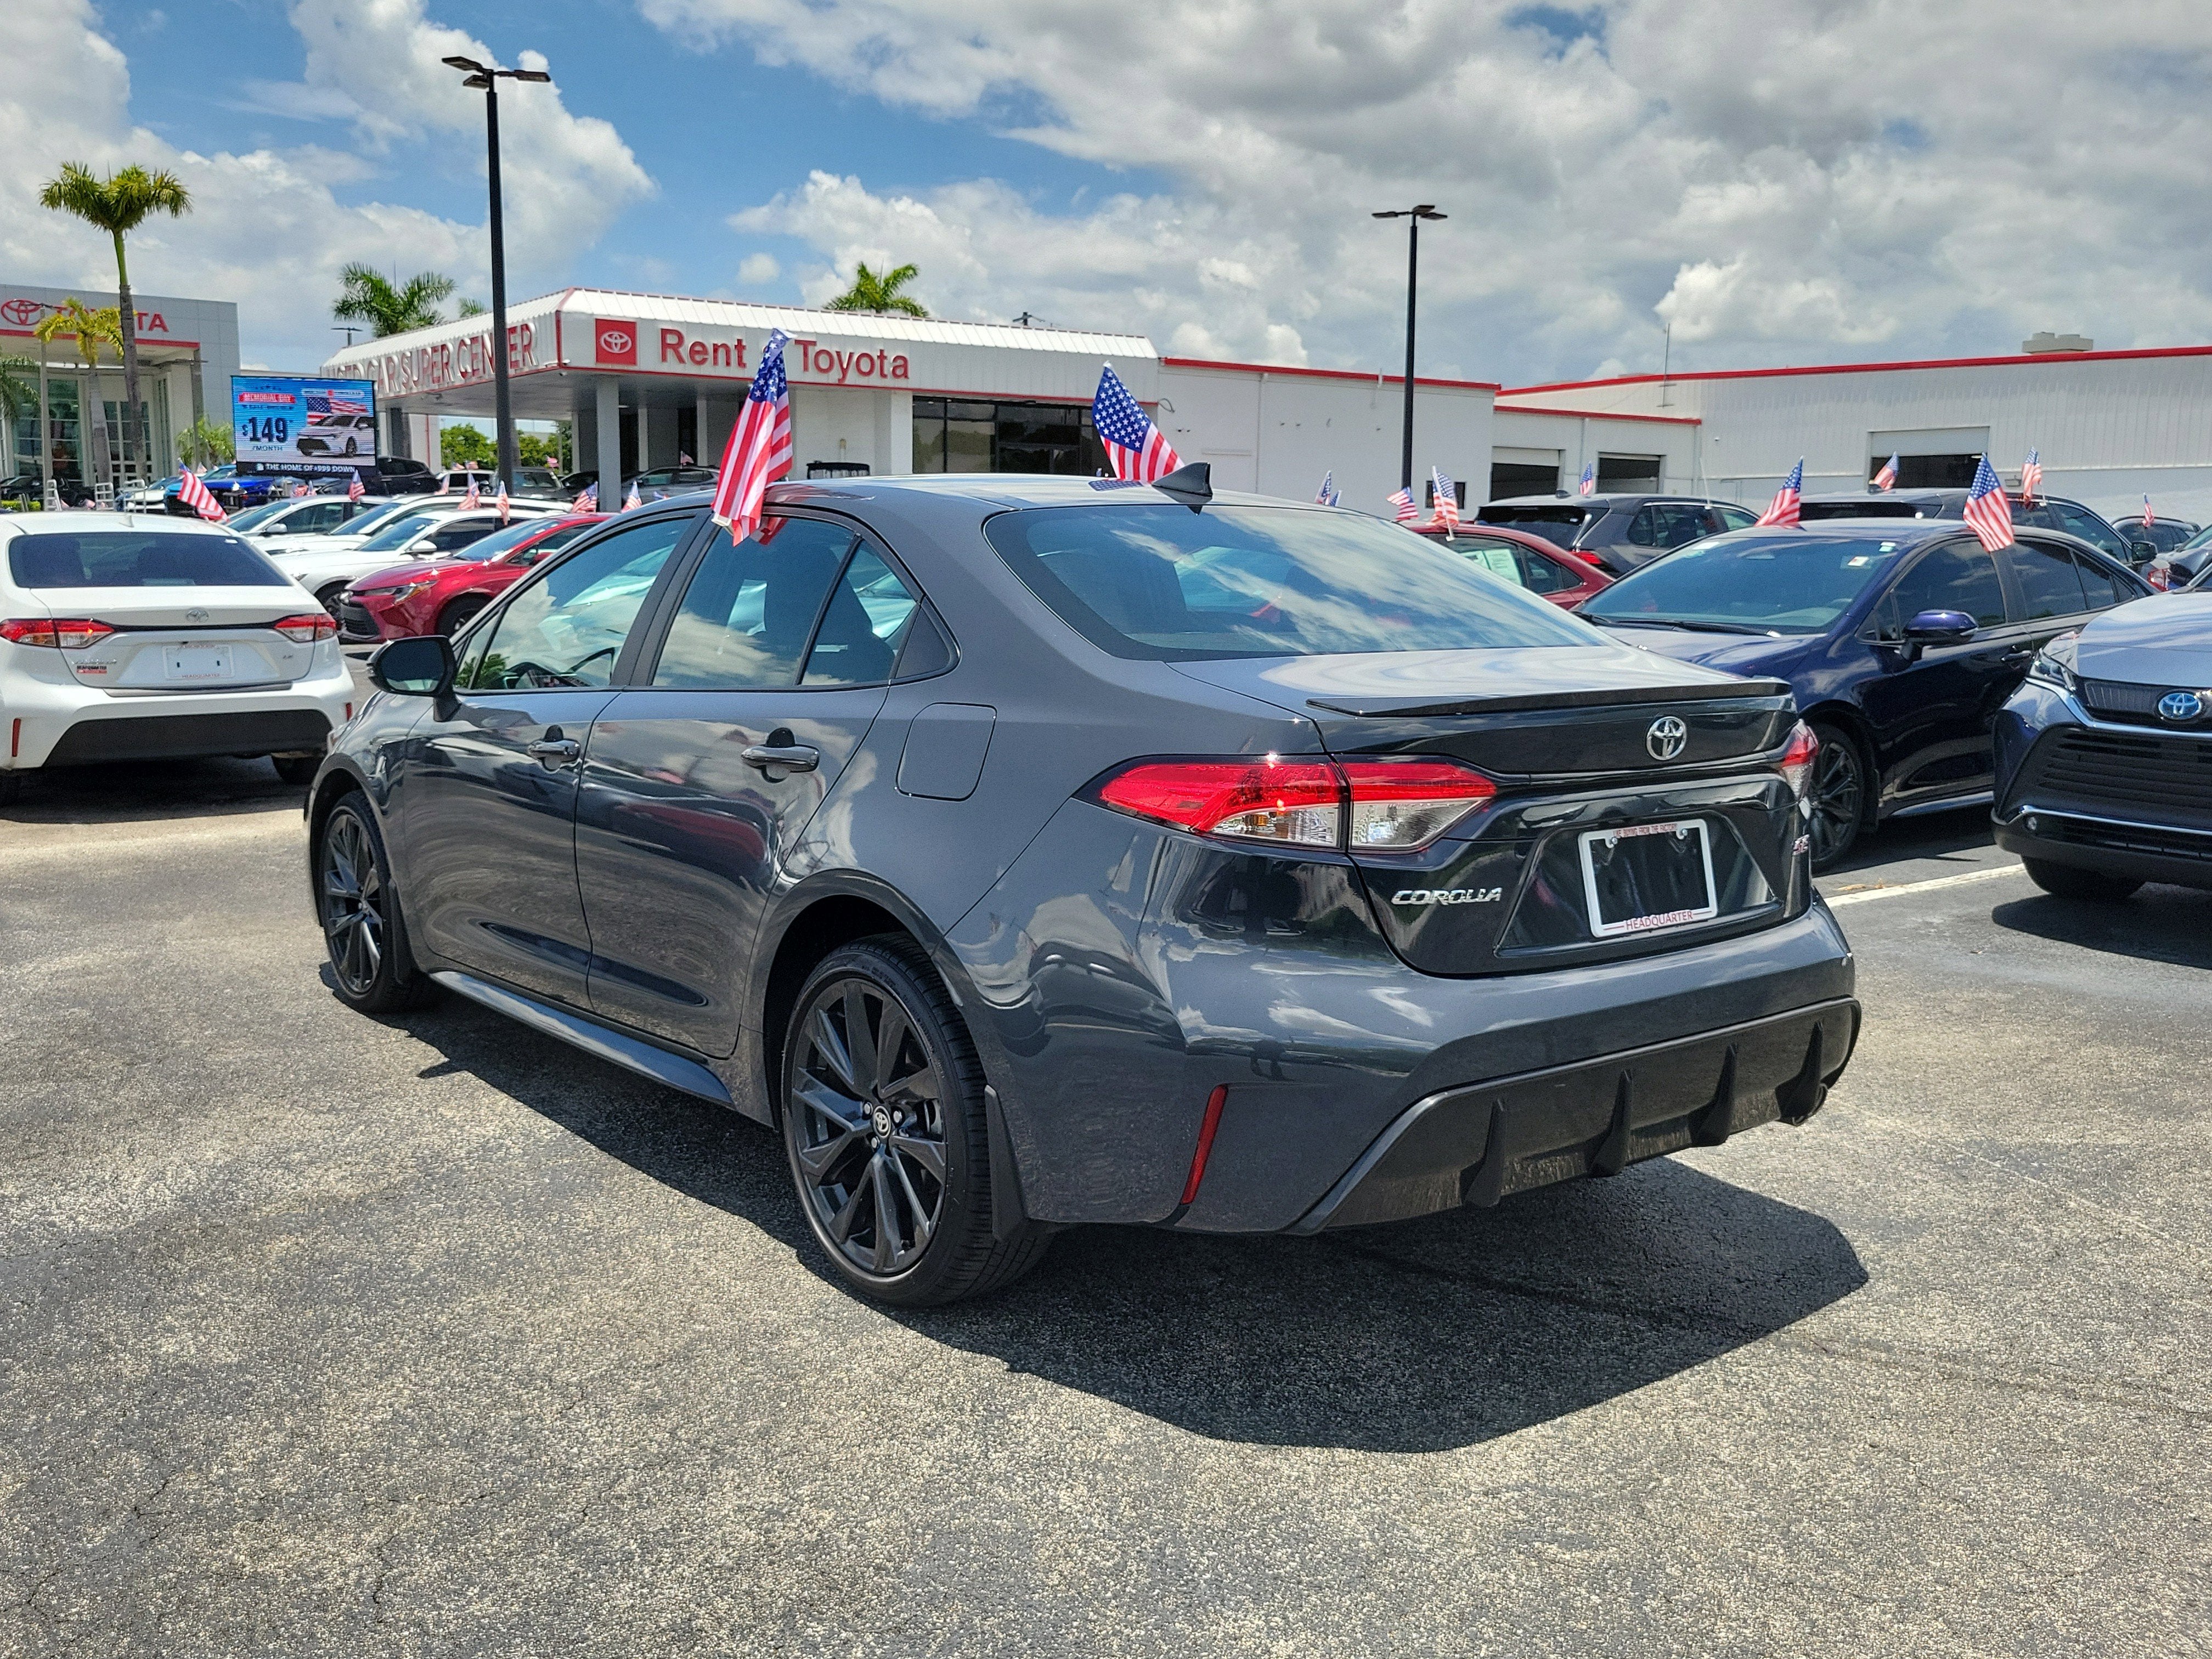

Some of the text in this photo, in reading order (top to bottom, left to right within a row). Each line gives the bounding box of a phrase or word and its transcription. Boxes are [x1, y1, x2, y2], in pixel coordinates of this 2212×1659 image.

[367, 323, 539, 395] CAR SUPER CENER
[660, 328, 910, 383] Rent Toyota
[1391, 887, 1503, 906] COROLLA
[1626, 911, 1694, 930] HEADQUARTER
